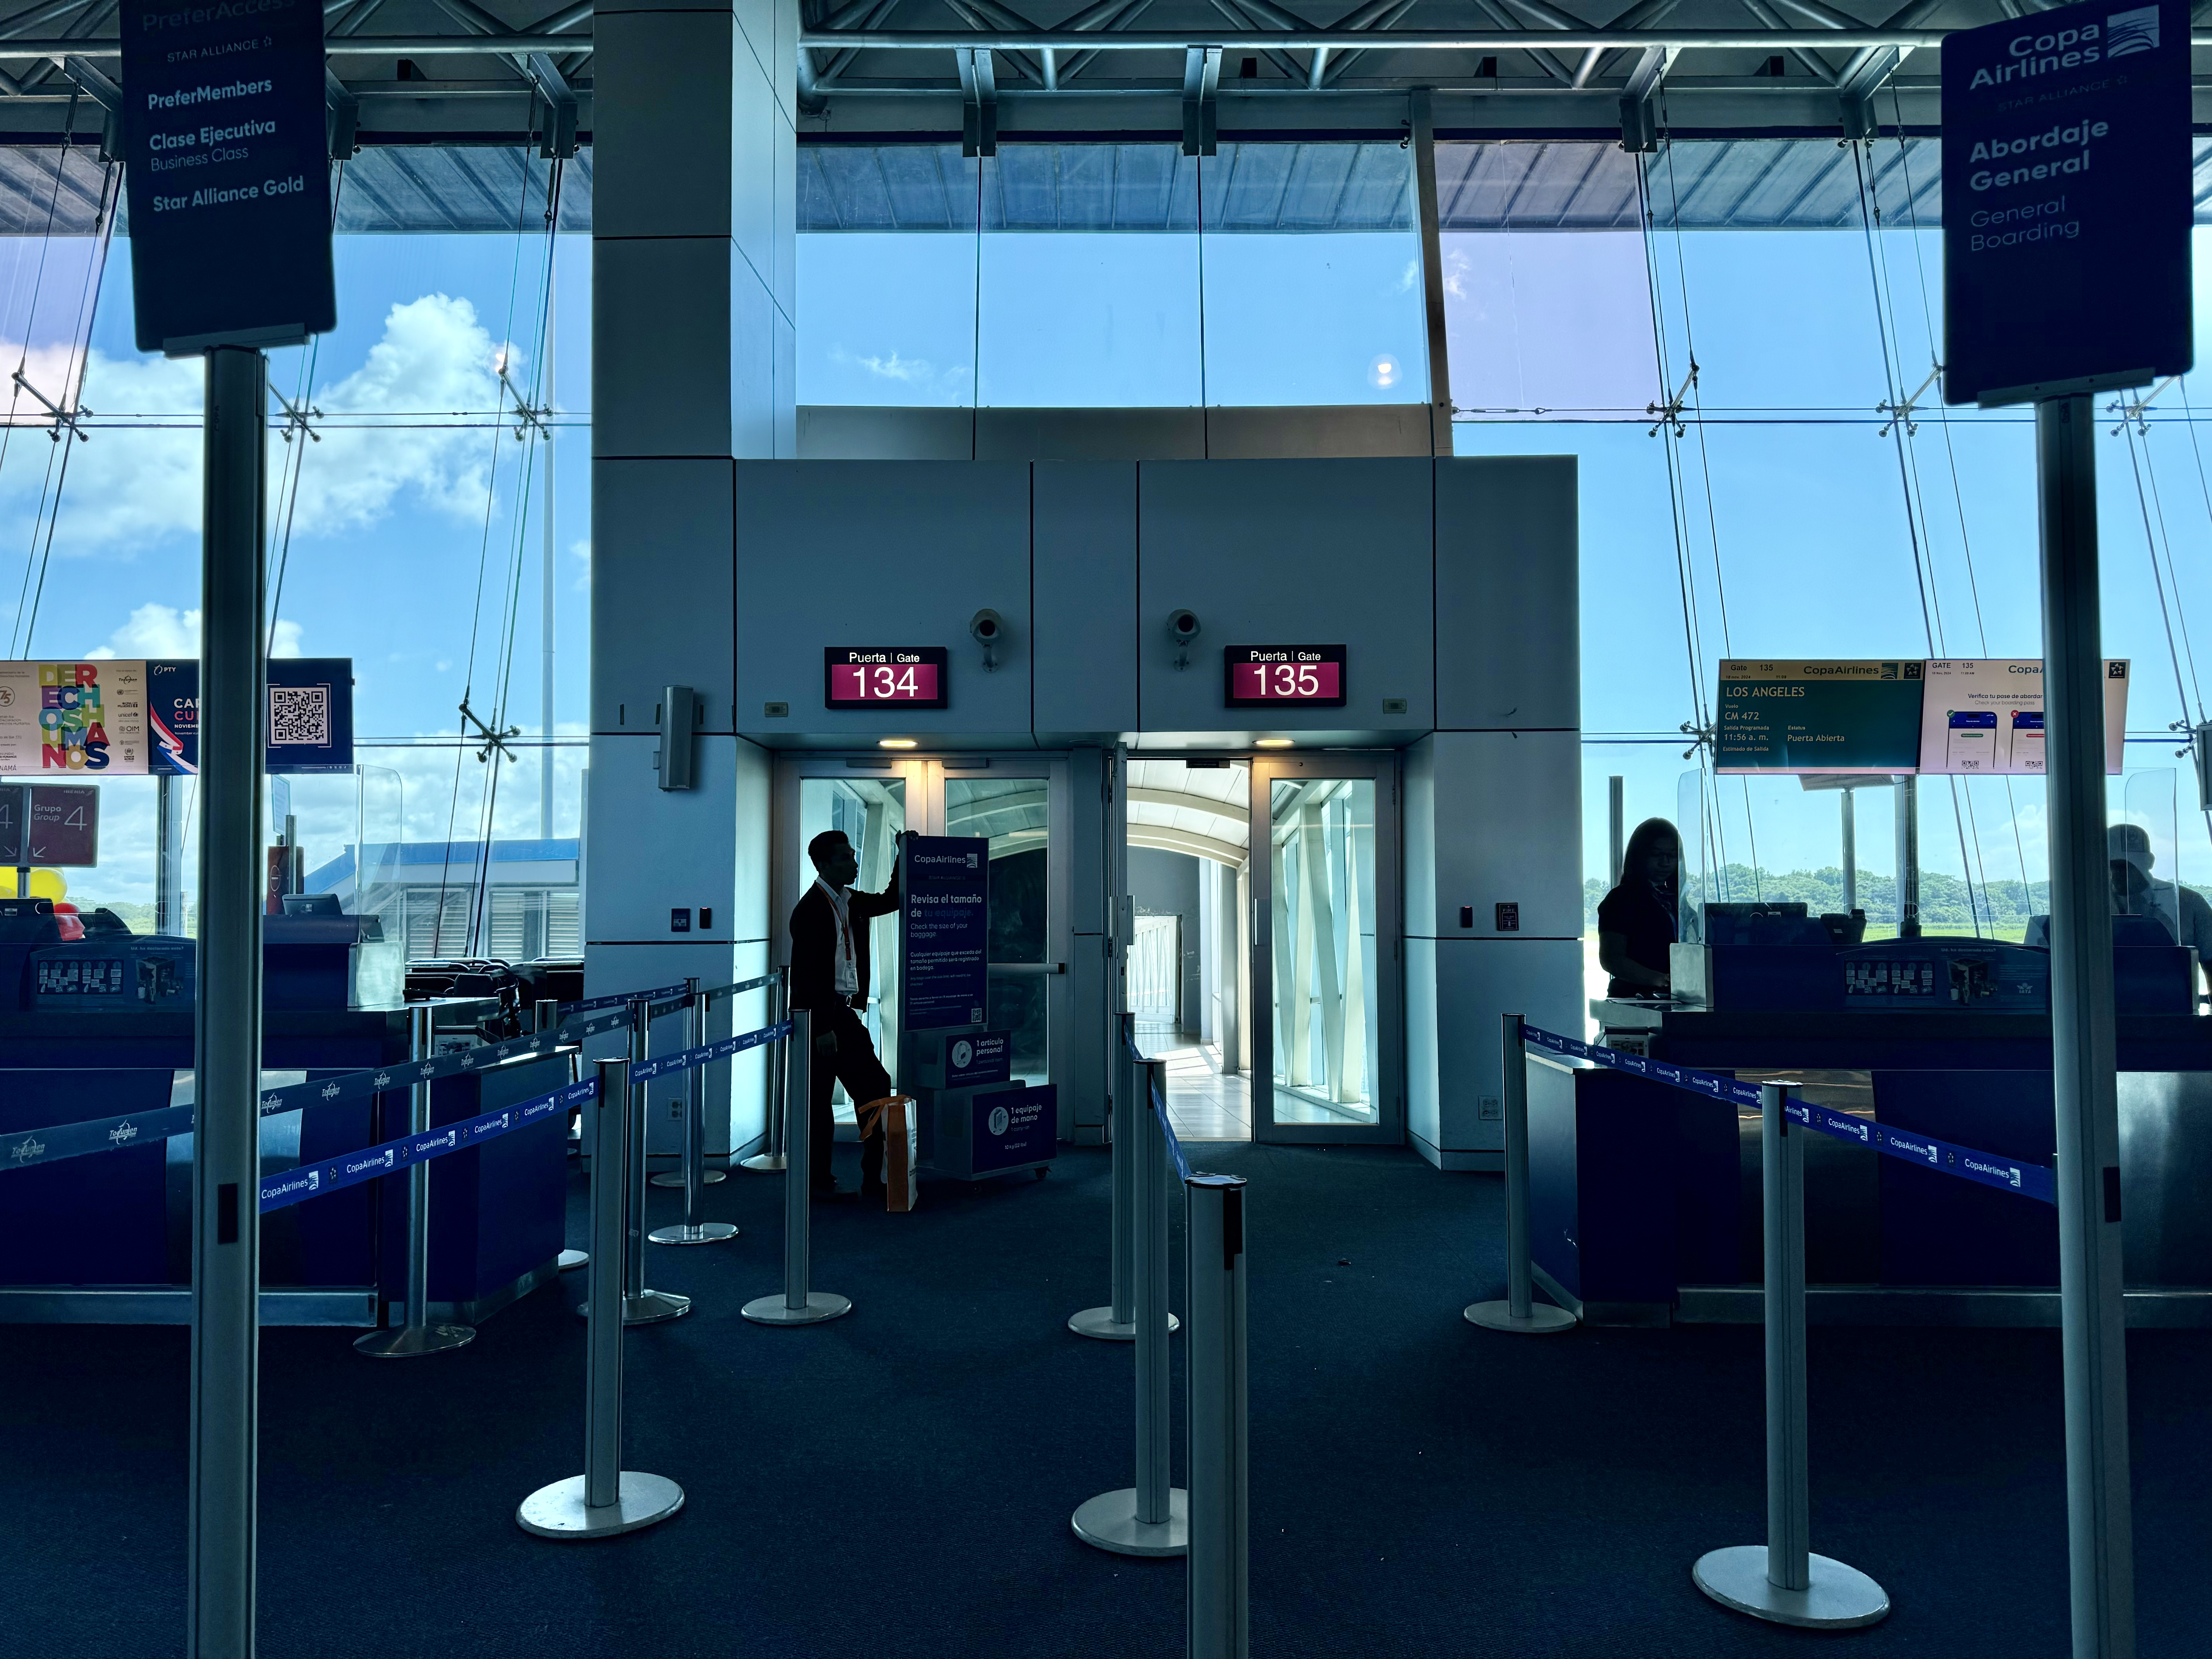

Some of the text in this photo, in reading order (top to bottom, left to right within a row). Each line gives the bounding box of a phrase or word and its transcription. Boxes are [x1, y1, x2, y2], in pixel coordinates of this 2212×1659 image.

[2009, 24, 2100, 57] Copa
[167, 38, 259, 63] STAR ALLIANCE
[1970, 46, 2100, 91] Airlines
[148, 79, 272, 109] PreferMembers
[1998, 79, 2110, 112] STAR ALLIANCE
[149, 120, 275, 150] Clase Ejecutiva
[1969, 119, 2109, 163] Abordaje
[151, 147, 248, 171] Business Class
[1970, 149, 2090, 191] General
[153, 176, 304, 211] Star Alliance Gold
[1971, 195, 2065, 228] General
[1971, 220, 2079, 251] Boarding
[849, 652, 920, 663] Puerta Gate
[1251, 651, 1321, 661] Puerta Gate
[39, 664, 98, 688] DER
[1804, 666, 1879, 675] CopaAirlines
[853, 666, 918, 697] 134
[1254, 665, 1319, 696] 135
[41, 684, 100, 710] ECH
[1727, 687, 1805, 697] LOS ANGELES
[39, 704, 105, 732] OSH
[174, 711, 199, 721] CU
[1725, 712, 1759, 720] CM 472
[41, 722, 110, 750] UMA
[42, 741, 109, 770] NOS
[34, 804, 62, 813] Grupo
[34, 813, 60, 822] Group
[64, 805, 87, 831] 4
[914, 855, 965, 864] CopaAirlines
[911, 893, 982, 903] Revisa el tamaño
[911, 908, 922, 917] de
[934, 907, 973, 919] equipaje.
[976, 1045, 1003, 1056] personal
[981, 1037, 1004, 1046] artículo
[1625, 1059, 1641, 1068] CopaAirlines
[1657, 1068, 1675, 1079] CopaAirlines
[1693, 1077, 1714, 1088] CopaAirlines
[568, 1087, 589, 1100] CopaAirlines
[1733, 1087, 1756, 1099] CopaAirlines
[524, 1102, 549, 1116] CopaAirlines
[1015, 1103, 1042, 1115] equipaje
[108, 1119, 137, 1145] Tocumen
[474, 1119, 502, 1133] CopaAirlines
[1828, 1118, 1860, 1135] CopaAirlines
[11, 1135, 45, 1163] Tocumen
[416, 1136, 448, 1152] CopaAirlines
[1891, 1137, 1928, 1156] CopaAirlines
[347, 1156, 385, 1174] CopaAirlines
[1965, 1158, 2009, 1178] CopaAirlines
[261, 1178, 308, 1199] CopaAirlines
